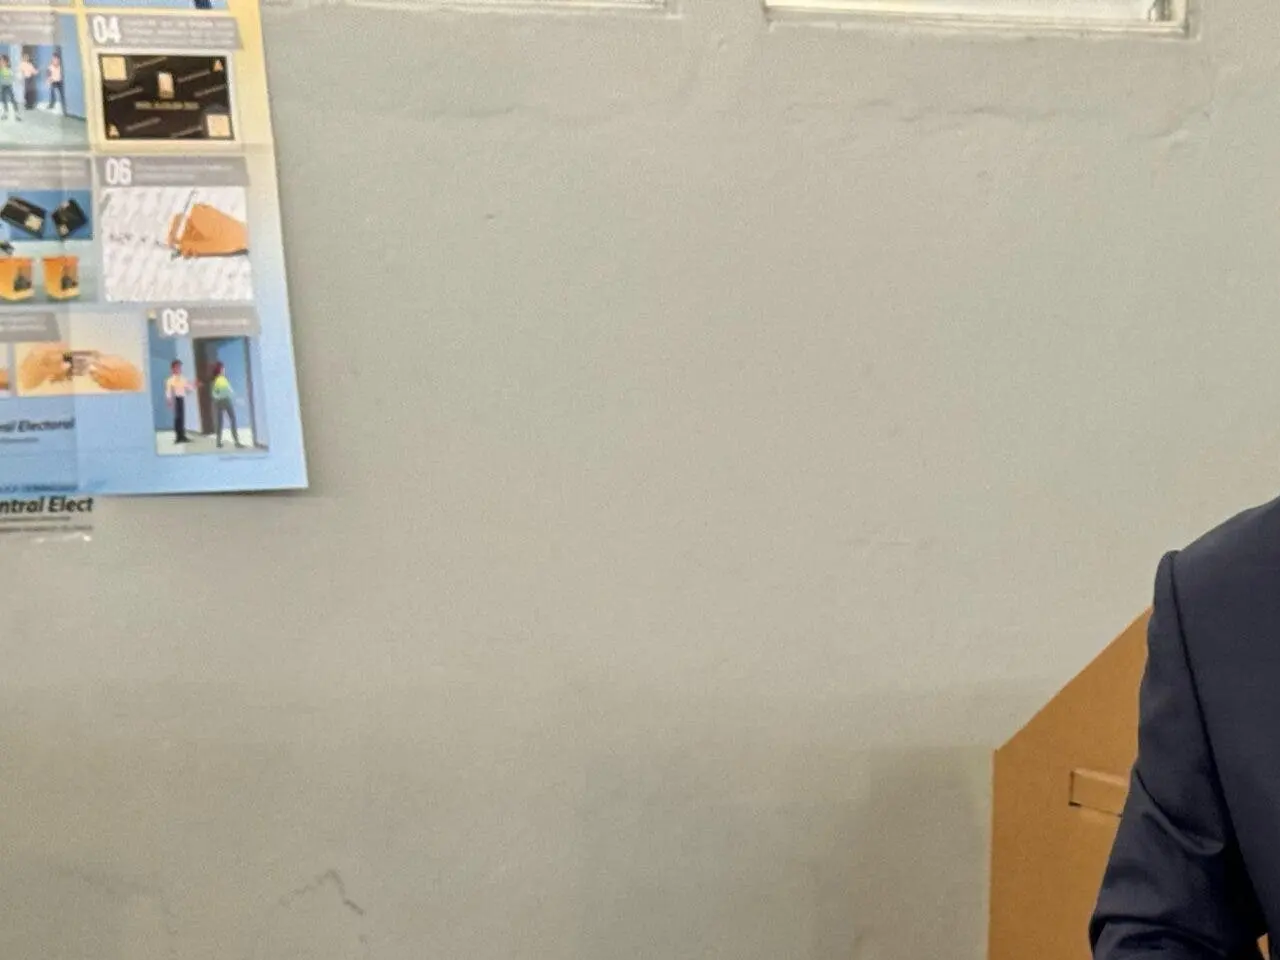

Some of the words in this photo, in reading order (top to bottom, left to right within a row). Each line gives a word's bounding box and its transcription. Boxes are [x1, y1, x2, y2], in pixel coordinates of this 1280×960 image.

[92, 15, 121, 43] 04
[105, 158, 131, 185] 06
[162, 308, 189, 335] 08
